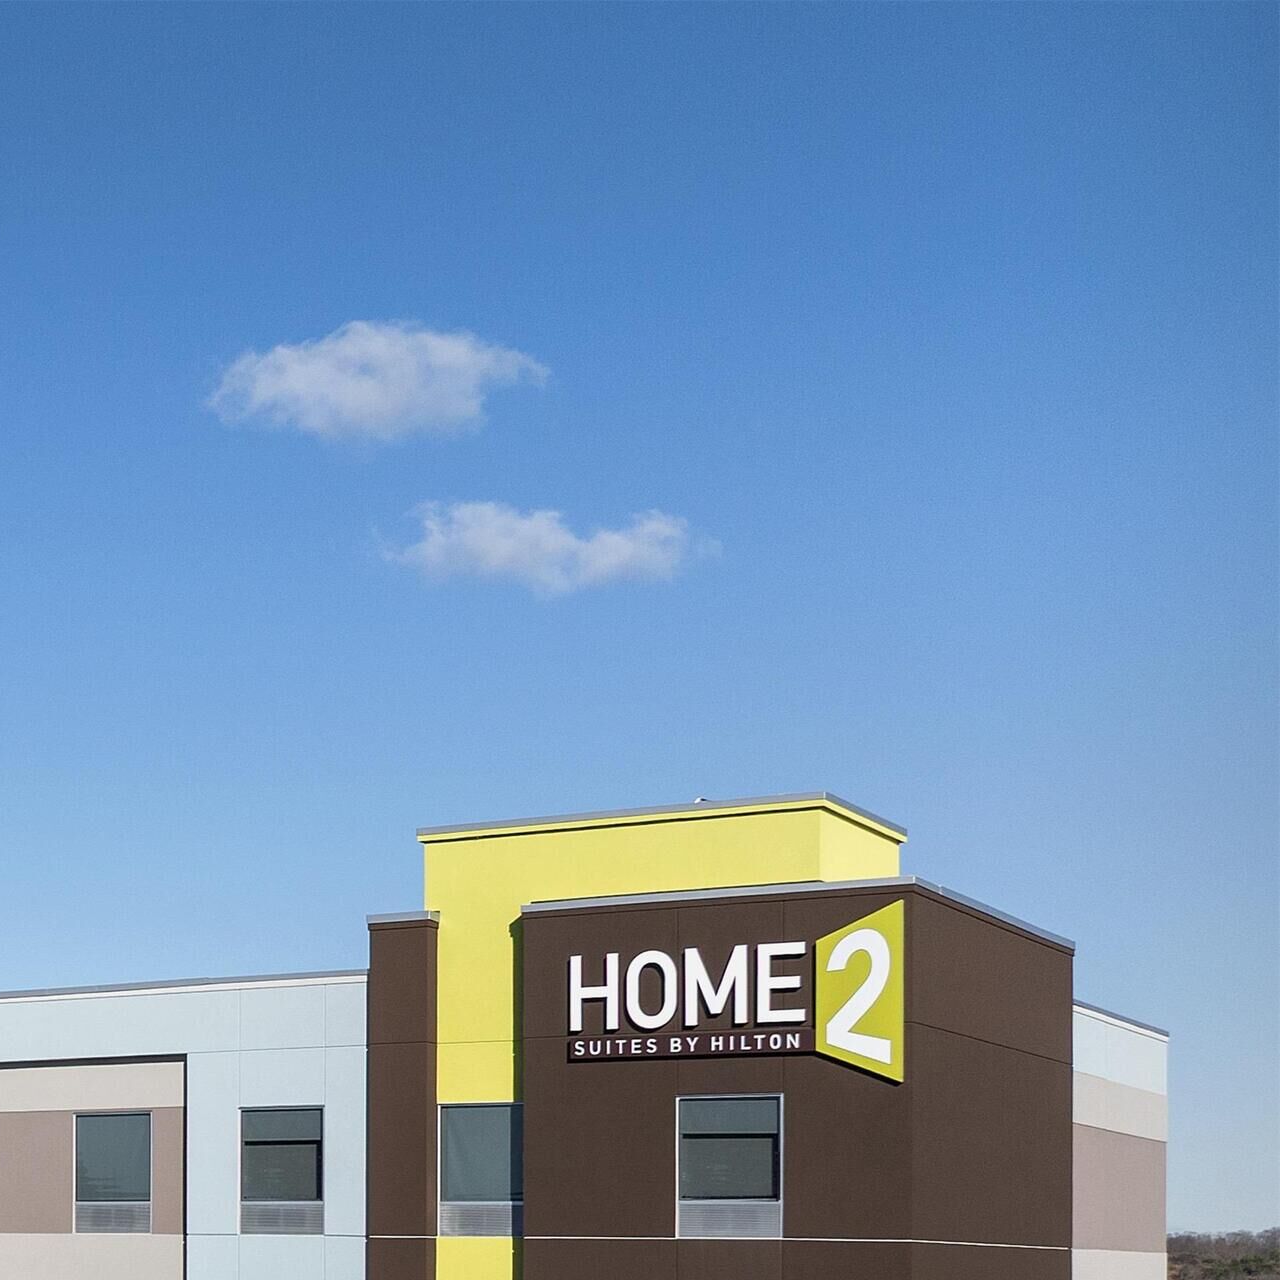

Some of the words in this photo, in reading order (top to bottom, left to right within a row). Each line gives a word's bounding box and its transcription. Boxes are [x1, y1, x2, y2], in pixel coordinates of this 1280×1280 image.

[574, 1039, 658, 1056] SUITES
[669, 1036, 699, 1053] BY
[711, 1033, 801, 1051] HILTON
